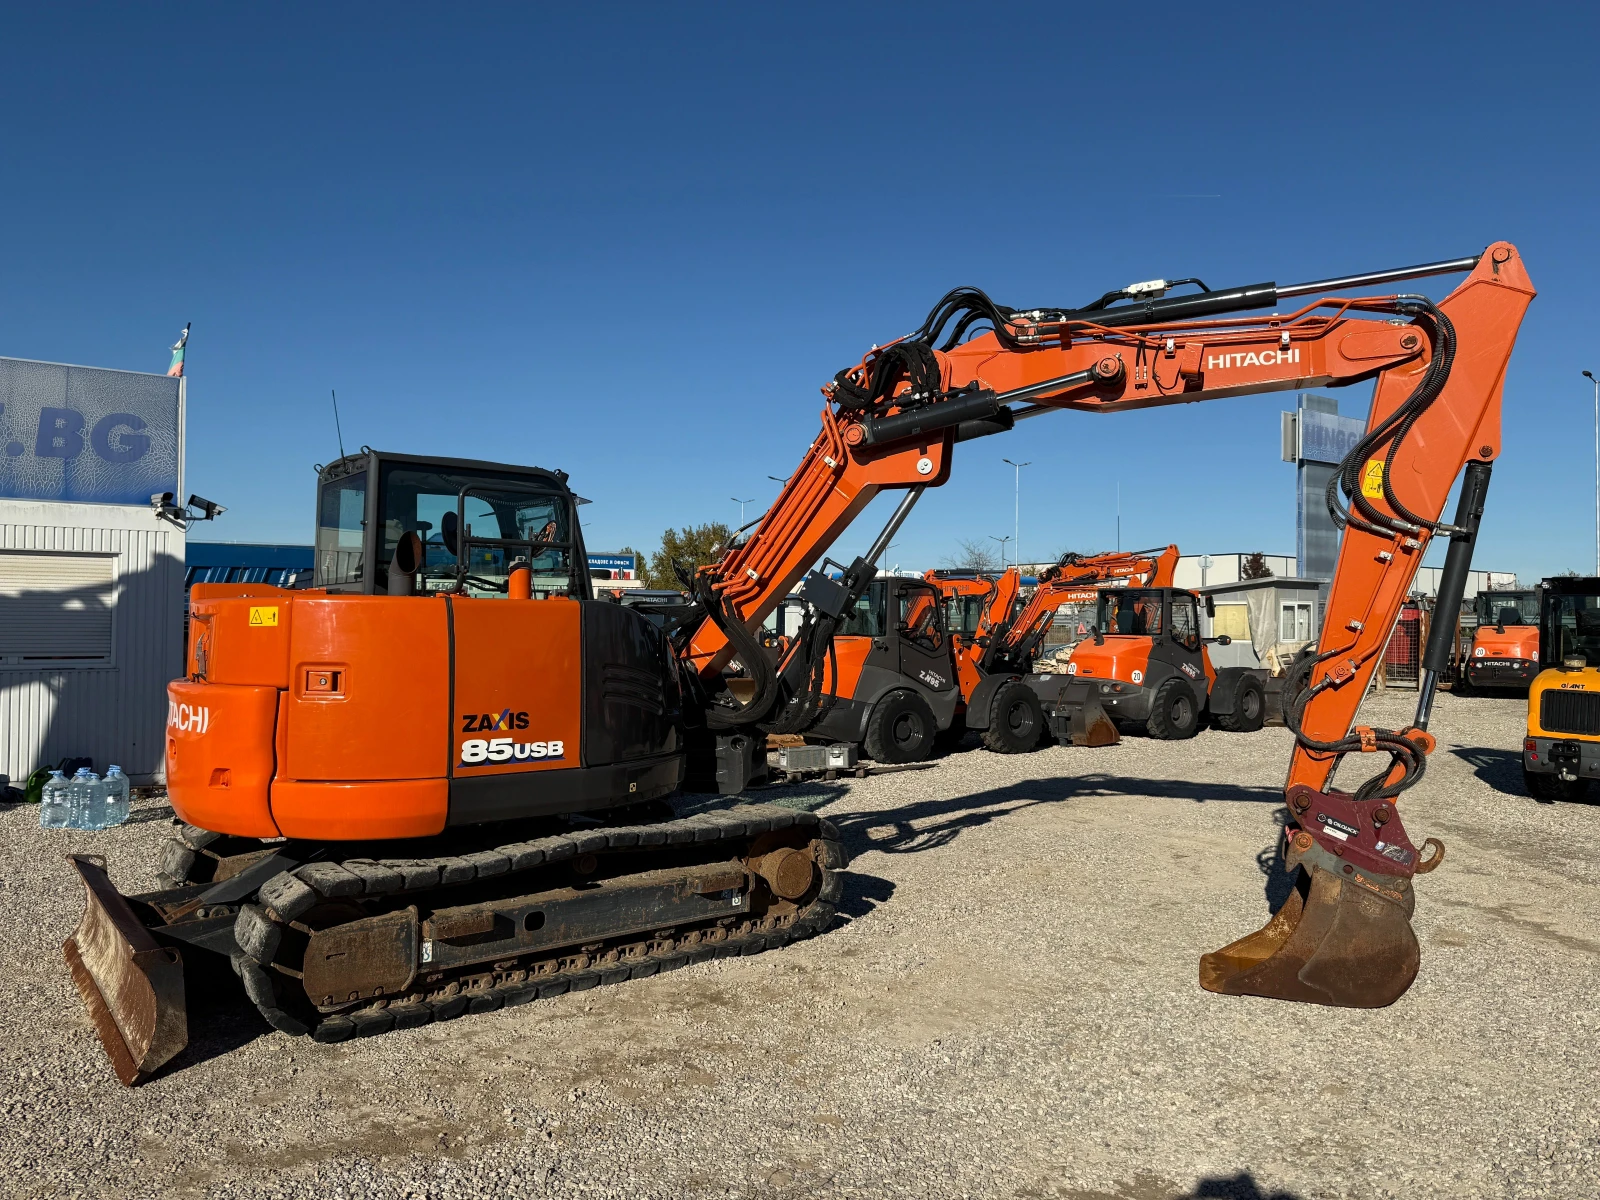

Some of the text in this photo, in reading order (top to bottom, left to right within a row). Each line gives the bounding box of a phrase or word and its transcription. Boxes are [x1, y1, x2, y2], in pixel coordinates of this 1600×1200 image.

[1208, 348, 1300, 369] HITACHI
[0, 402, 151, 463] .BG
[1476, 648, 1484, 656] 20
[1069, 664, 1076, 673] 20
[1133, 672, 1141, 681] 20
[168, 701, 209, 734] TACHI
[462, 709, 530, 733] ZAXIS
